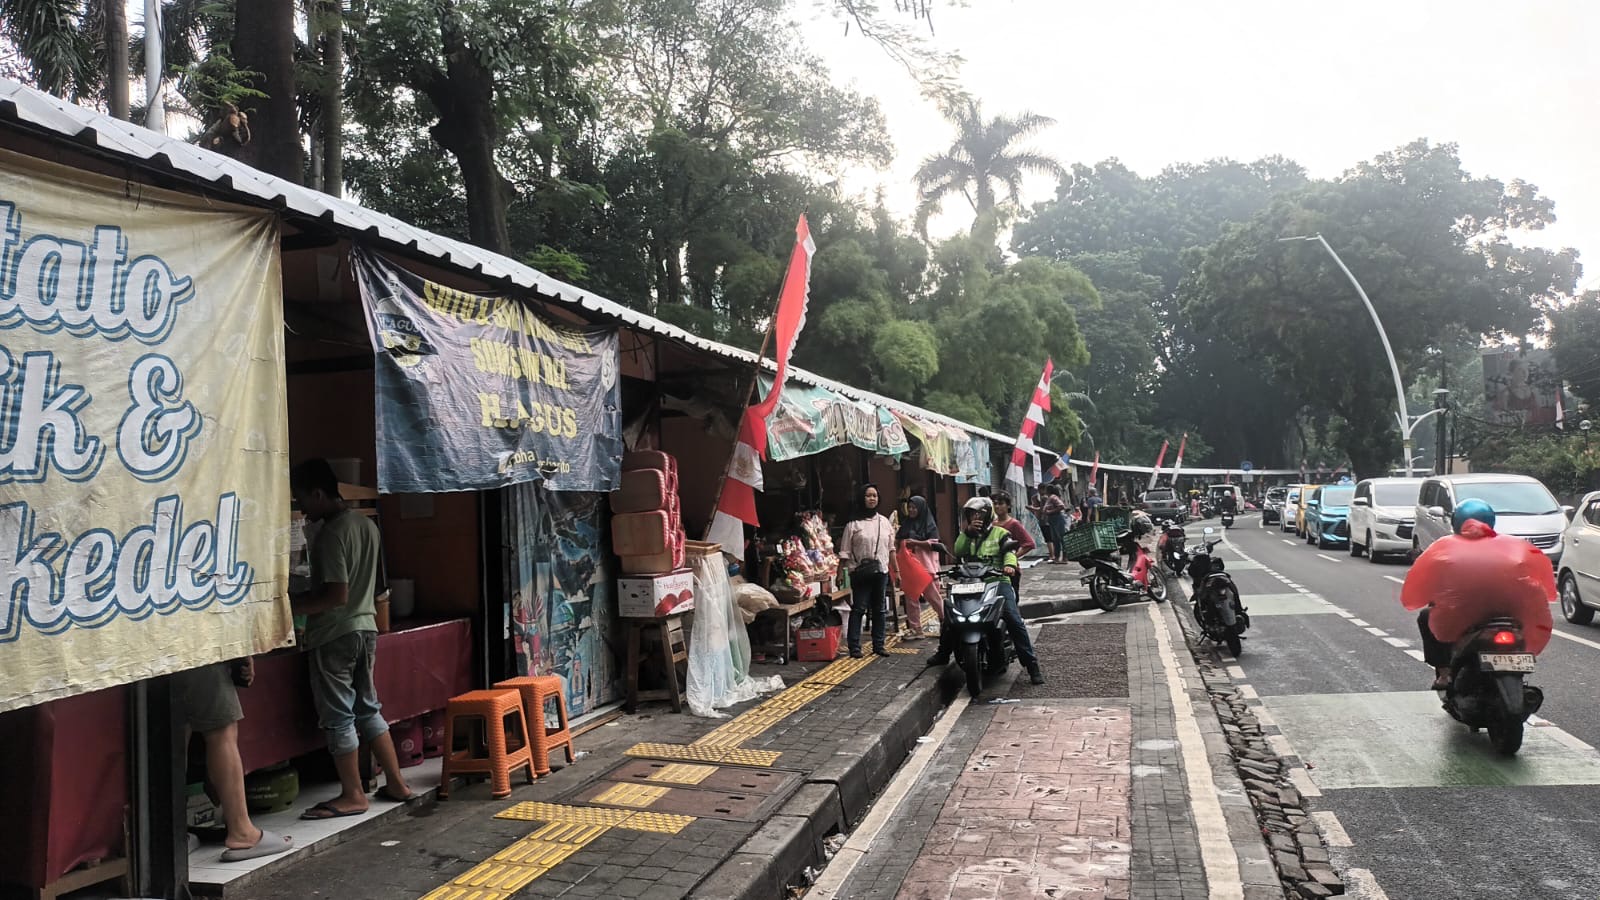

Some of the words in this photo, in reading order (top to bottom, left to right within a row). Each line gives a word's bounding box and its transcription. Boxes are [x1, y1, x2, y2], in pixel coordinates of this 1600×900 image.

[423, 279, 476, 322] SOTO
[475, 297, 489, 326] &
[116, 353, 204, 484] &
